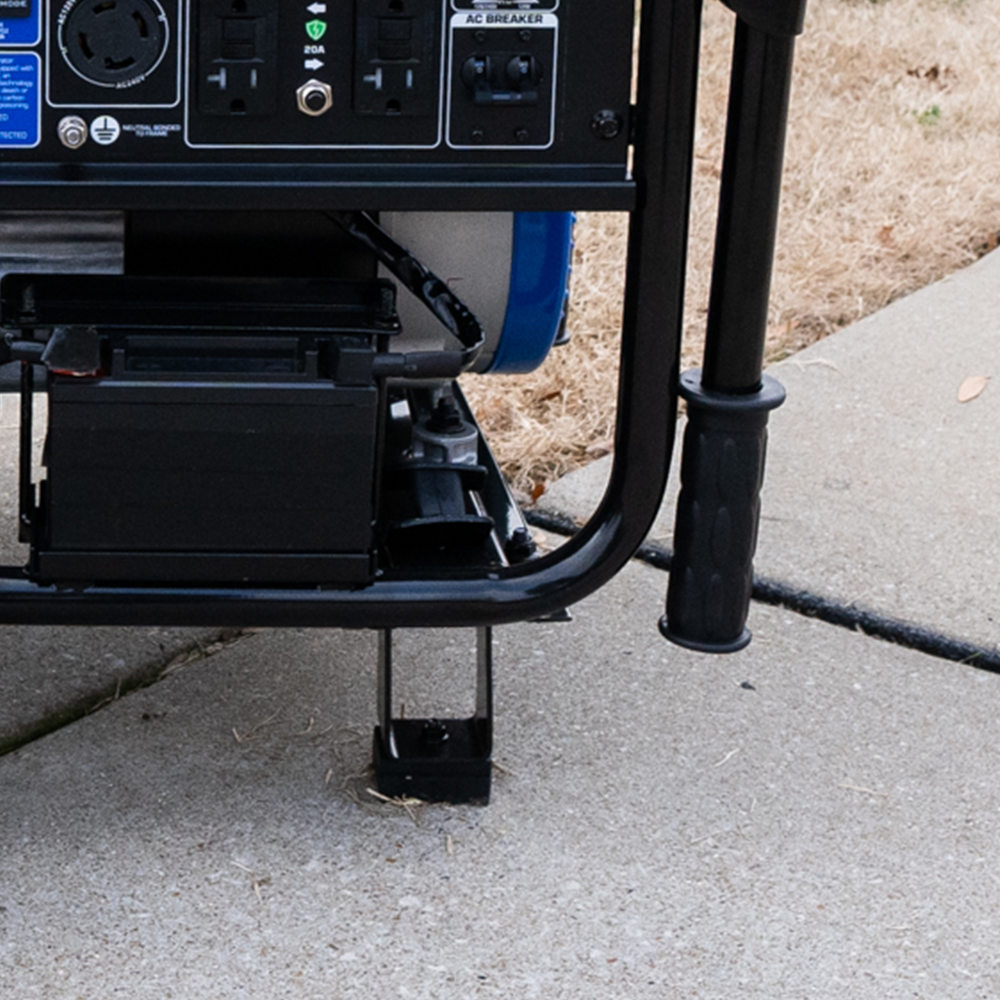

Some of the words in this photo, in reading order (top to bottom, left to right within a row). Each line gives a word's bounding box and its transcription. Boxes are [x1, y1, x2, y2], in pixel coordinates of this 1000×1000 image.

[465, 13, 484, 24] AC
[485, 13, 544, 24] BREAKER
[303, 44, 326, 55] 20A
